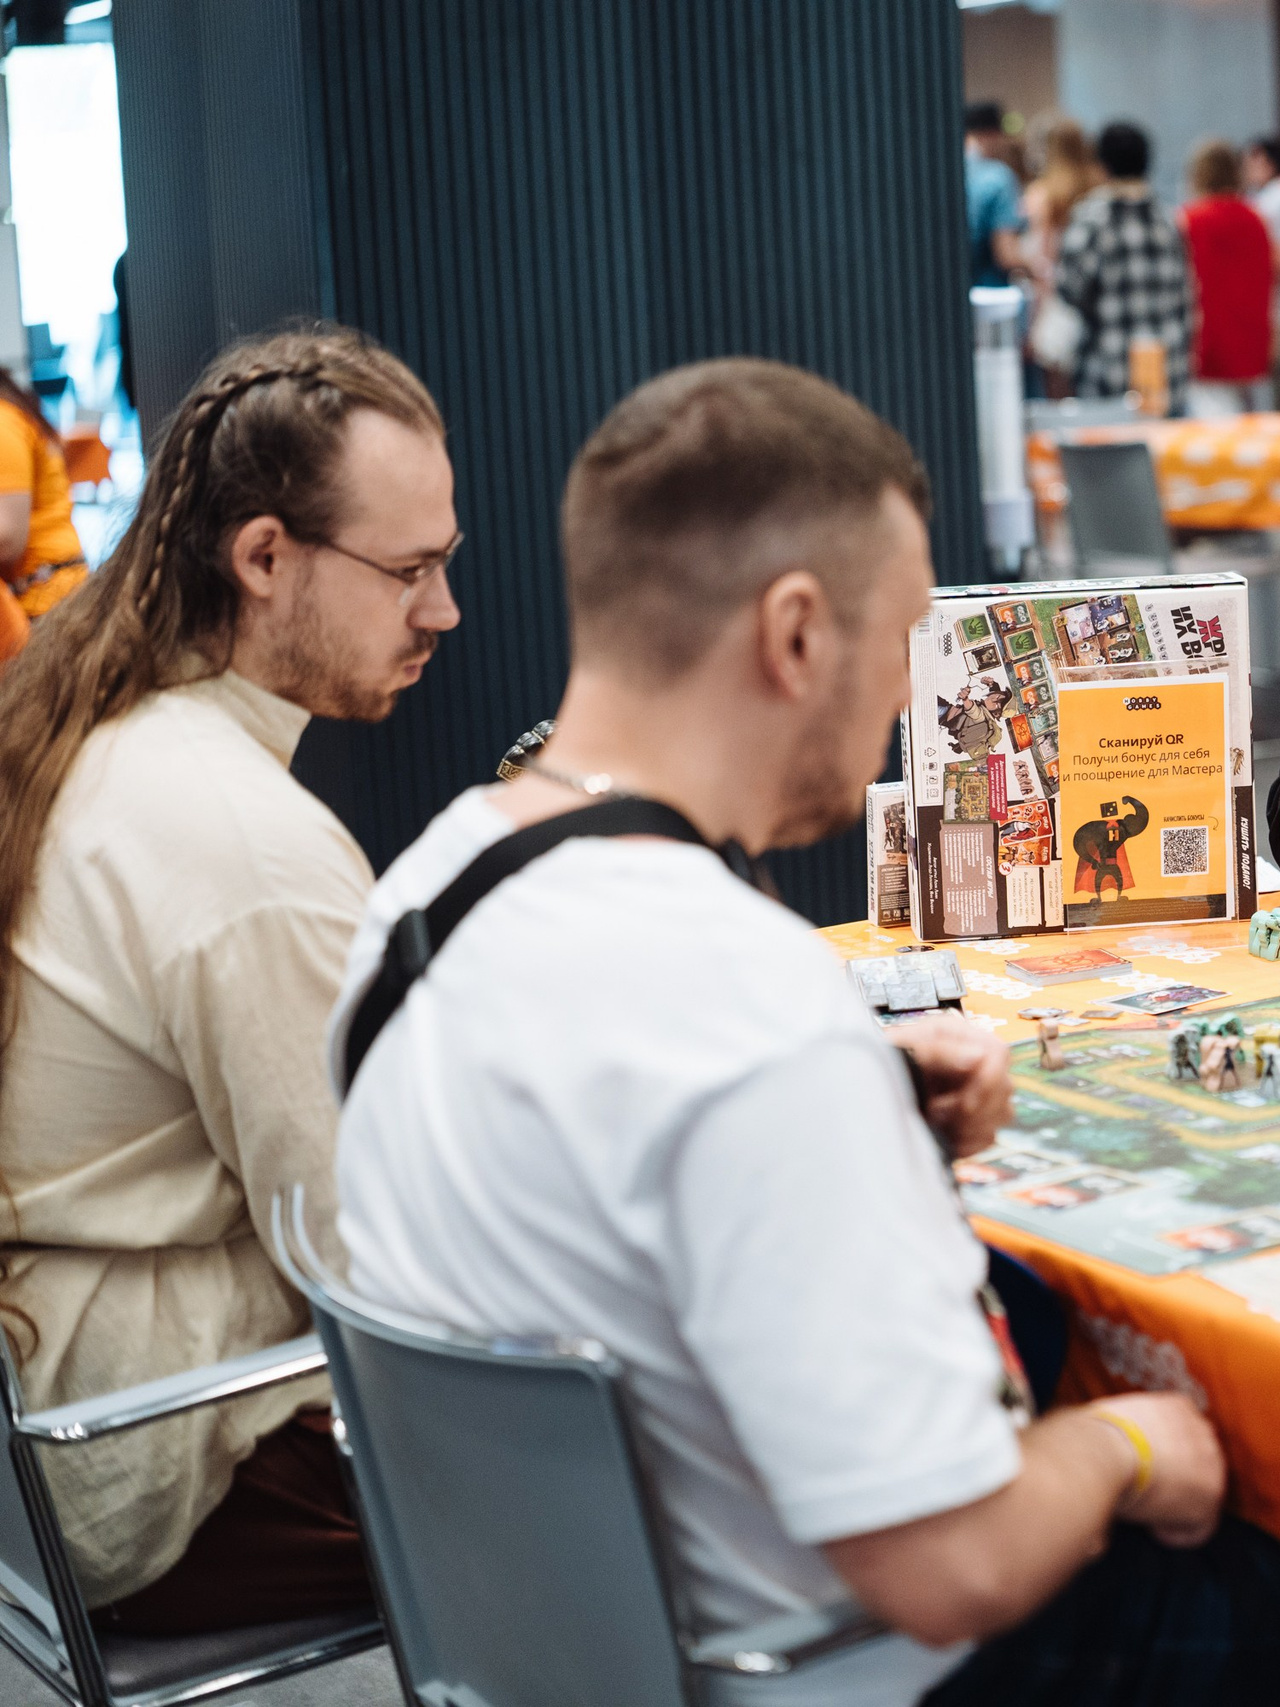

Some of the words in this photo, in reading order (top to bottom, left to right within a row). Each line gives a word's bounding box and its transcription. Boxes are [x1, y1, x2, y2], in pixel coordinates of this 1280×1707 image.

[1171, 606, 1197, 639] ИХ
[1123, 696, 1158, 705] HOBBY
[1127, 702, 1161, 711] GAMES
[1099, 735, 1163, 749] Сканируй
[1166, 734, 1184, 745] QR
[1073, 754, 1119, 768] Получи
[1121, 751, 1157, 766] бонус
[1159, 752, 1180, 763] для
[1183, 748, 1210, 759] себя
[1063, 773, 1071, 782] и
[1073, 770, 1145, 783] поощрение
[1148, 768, 1169, 779] для
[1172, 764, 1223, 777] Мастера
[1240, 816, 1249, 851] КУШАТЬ
[1241, 852, 1251, 890] ПОДАНО!
